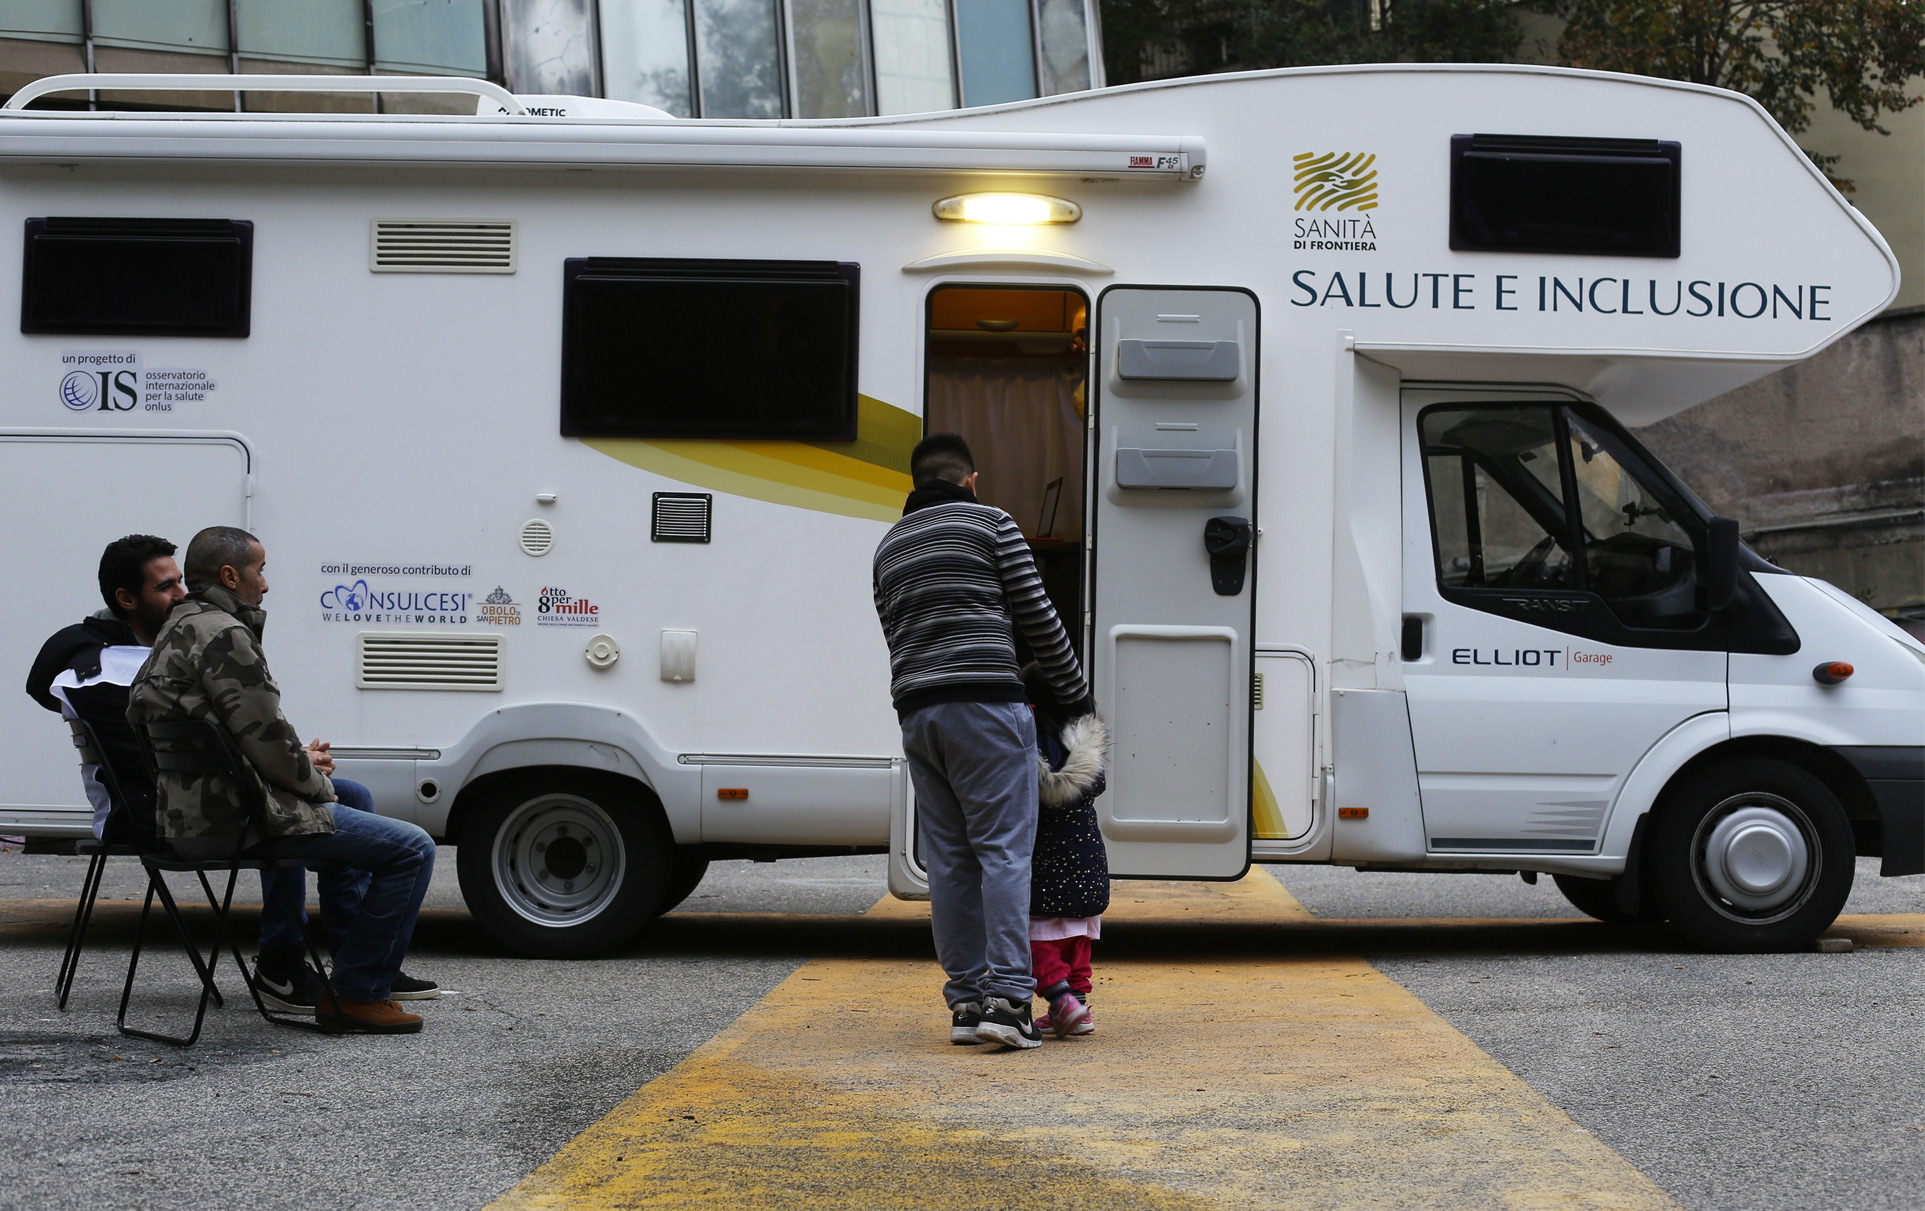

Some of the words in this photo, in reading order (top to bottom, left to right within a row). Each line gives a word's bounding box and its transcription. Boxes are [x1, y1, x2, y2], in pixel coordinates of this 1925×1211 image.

[1129, 156, 1153, 166] FIAMMA
[1294, 213, 1377, 240] SANITÀ
[1294, 240, 1306, 250] DI
[1310, 240, 1377, 251] FRONTIERA
[1290, 270, 1476, 311] SALUTE
[1494, 274, 1518, 311] E
[1538, 275, 1832, 322] INCLUSIONE
[62, 355, 76, 364] un
[77, 354, 124, 366] progetto
[125, 353, 136, 364] di
[145, 370, 206, 380] osservatorio
[145, 381, 215, 391] internazionale
[145, 392, 163, 403] per
[163, 391, 173, 401] la
[174, 391, 204, 401] salute
[145, 402, 172, 412] onlus
[320, 564, 340, 574] con
[342, 563, 349, 574] il
[350, 564, 401, 576] generoso
[402, 565, 459, 576] contributo
[461, 565, 471, 576] di
[481, 605, 516, 616] OBOLO
[556, 599, 599, 615] mille
[1502, 598, 1590, 612] TRANST
[488, 615, 521, 626] PIETRO
[1452, 648, 1562, 667] ELLIOT
[1573, 651, 1613, 667] Garage
